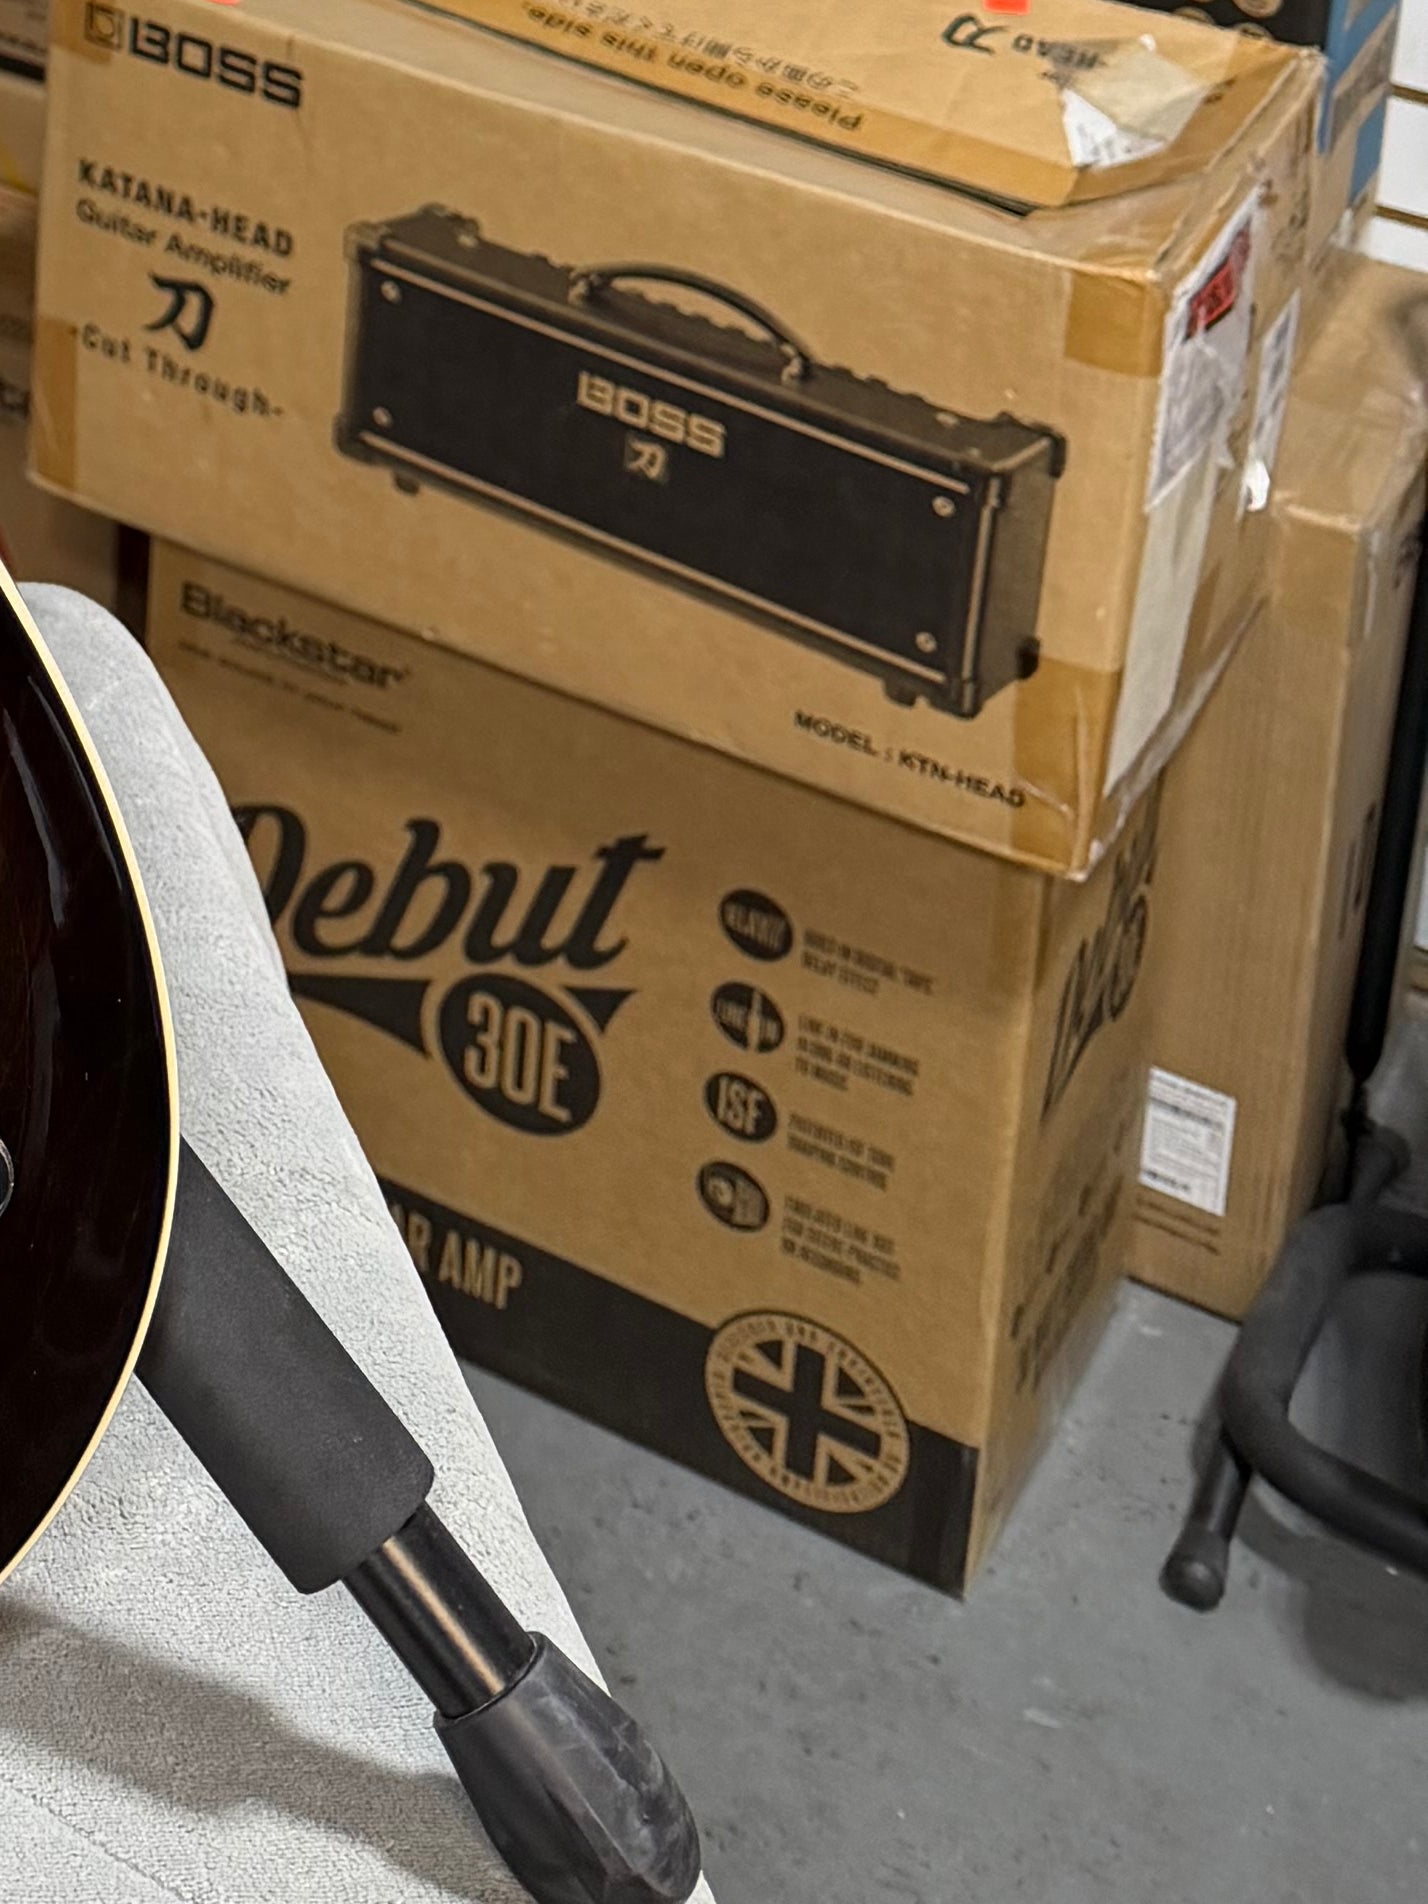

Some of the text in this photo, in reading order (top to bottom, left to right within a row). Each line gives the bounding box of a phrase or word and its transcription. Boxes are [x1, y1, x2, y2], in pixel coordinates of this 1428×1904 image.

[128, 15, 304, 110] BOSS
[667, 53, 748, 90] open
[756, 82, 863, 133] Please
[76, 198, 292, 297] Guitar Amplifier
[78, 157, 294, 258] KATANA-HEAD
[576, 370, 727, 459] BOSS
[180, 581, 406, 689] Blackstar
[794, 709, 878, 758] MODEL
[898, 748, 1026, 808] KTN-HEAD
[232, 805, 667, 969] Debut
[463, 991, 577, 1123] 30E
[718, 1076, 765, 1135] ISF
[439, 1230, 523, 1310] AMP
